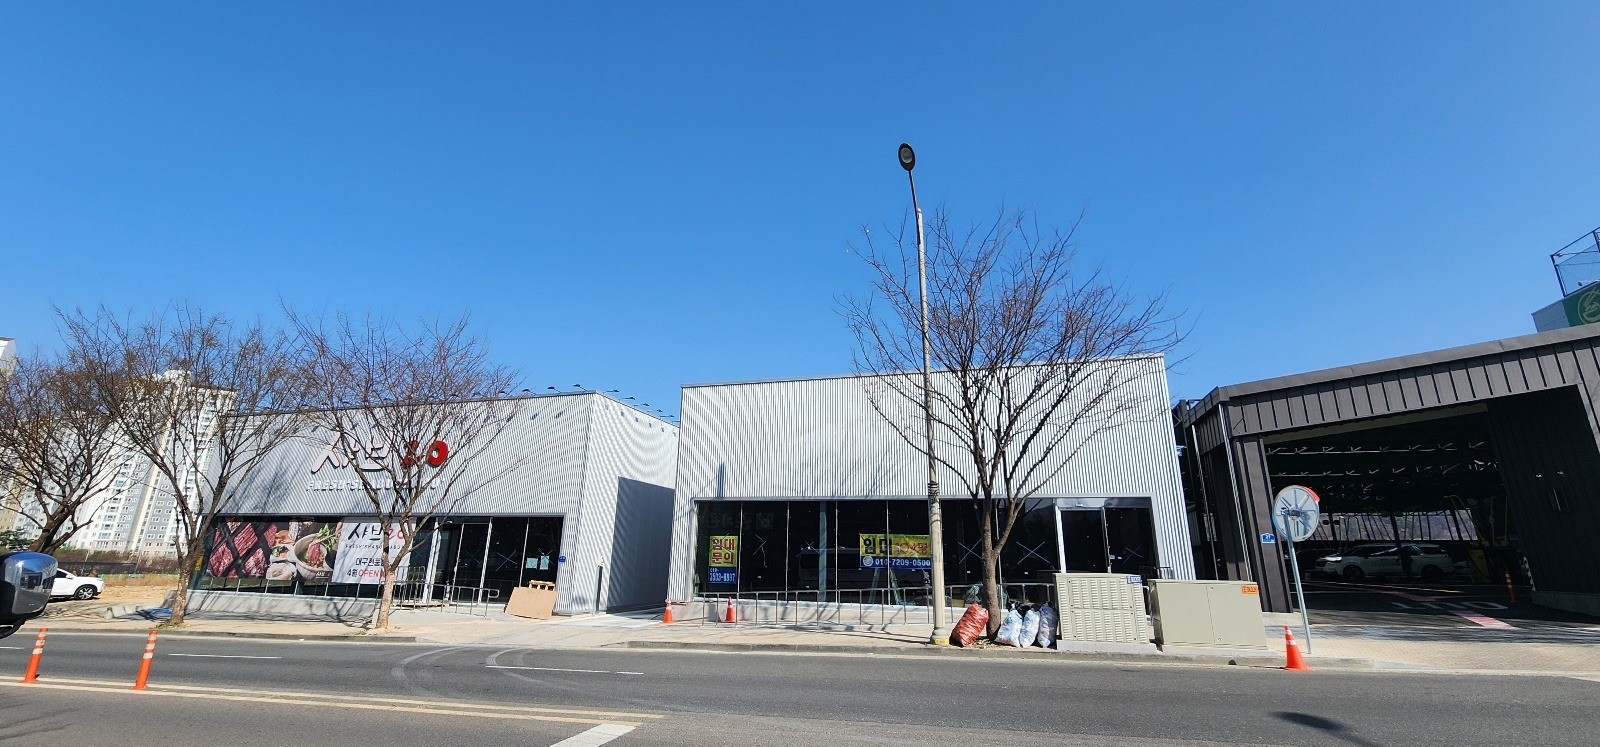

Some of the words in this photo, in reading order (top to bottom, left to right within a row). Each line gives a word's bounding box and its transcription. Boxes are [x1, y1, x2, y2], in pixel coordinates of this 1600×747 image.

[713, 538, 735, 551] 임대
[863, 537, 893, 556] 임대
[712, 552, 734, 565] 문의
